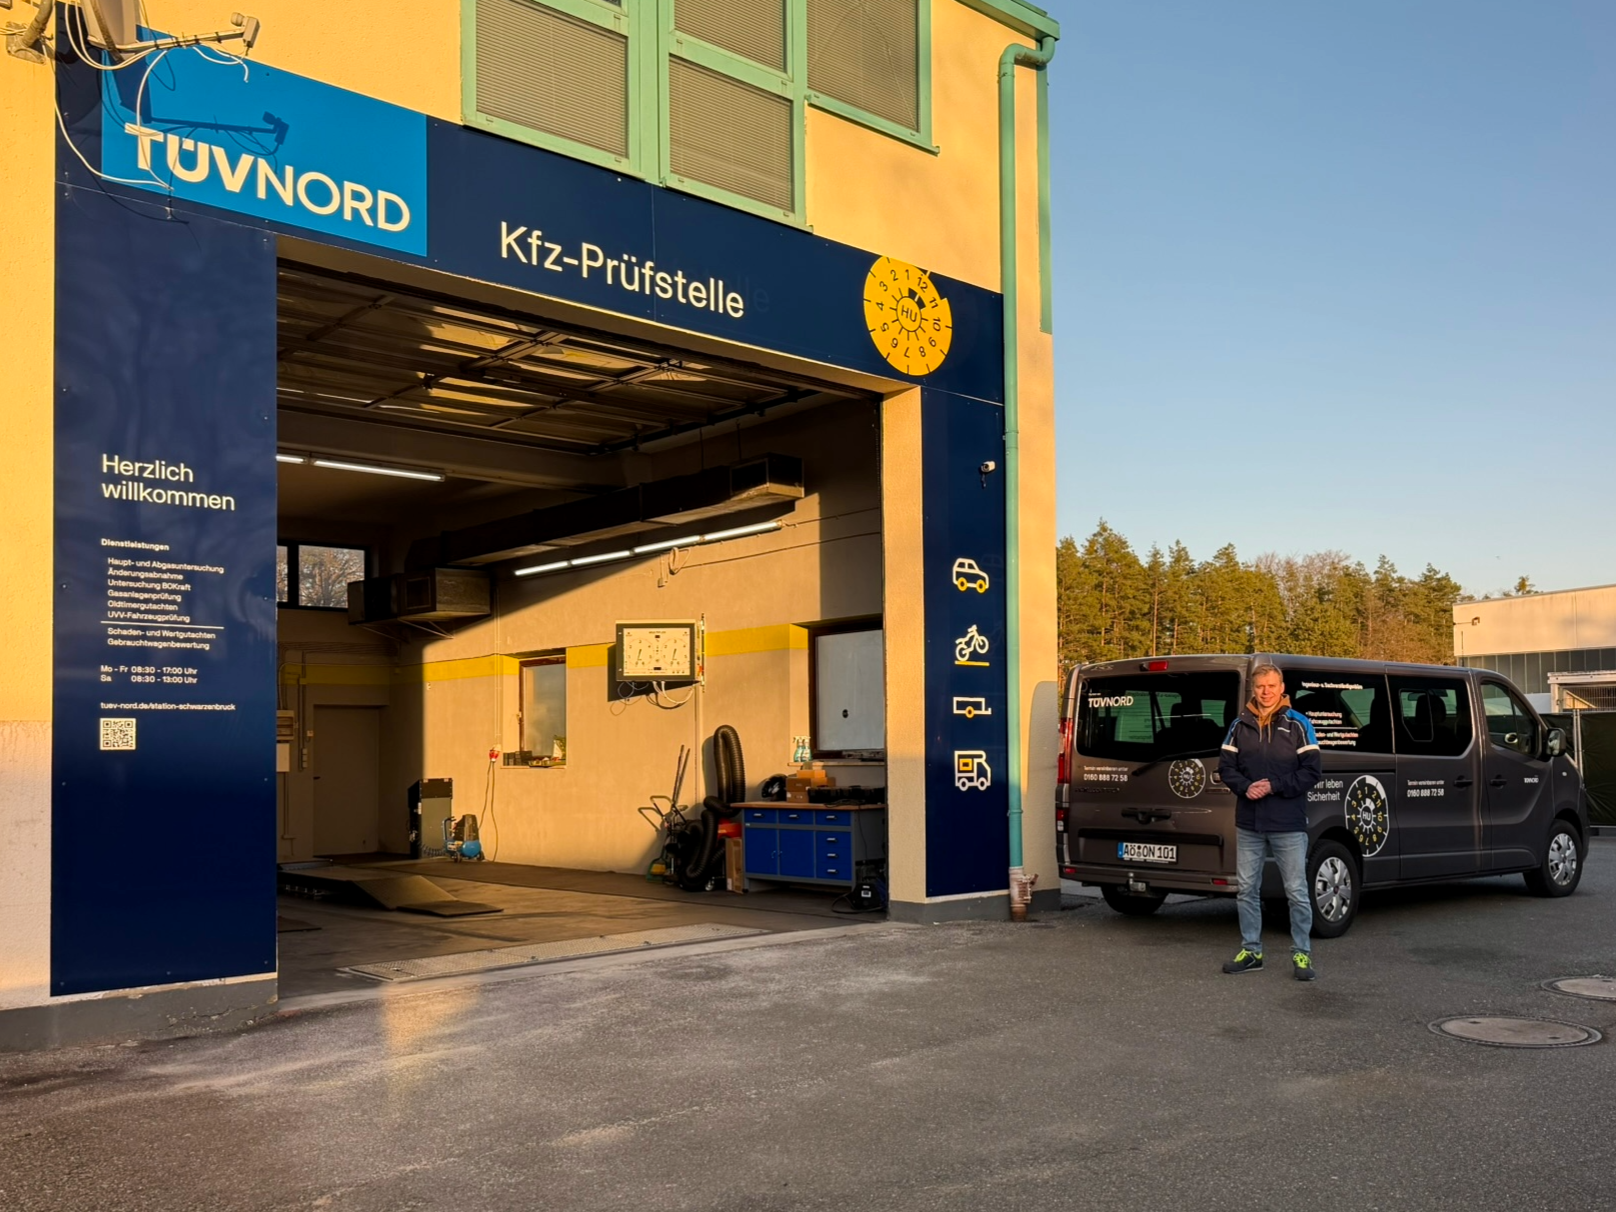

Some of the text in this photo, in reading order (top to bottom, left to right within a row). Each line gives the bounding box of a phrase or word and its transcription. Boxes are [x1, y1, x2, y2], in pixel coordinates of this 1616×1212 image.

[124, 122, 411, 232] TÜVNORD
[501, 221, 744, 318] Kfz-Prüfstelle
[890, 269, 898, 281] 2
[905, 269, 910, 281] 1
[879, 281, 888, 292] 3
[917, 276, 928, 293] 12
[876, 301, 884, 311] 4
[929, 297, 938, 309] 11
[901, 305, 918, 322] HU
[880, 322, 889, 332] 5
[932, 317, 941, 331] 10
[904, 347, 910, 358] 7
[919, 346, 926, 357] 8
[103, 454, 193, 482] Herzlich
[102, 481, 235, 511] willkommen
[101, 538, 169, 551] Dienstleistungen
[107, 557, 134, 567] Haupt-
[151, 561, 224, 574] Abgasuntersuchung
[107, 579, 191, 591] Untersuchung BOKraft
[107, 599, 178, 610] Oldtimergutachten
[107, 627, 216, 639] Schaden- und Wertgutachten
[184, 667, 198, 675] Uhr
[100, 674, 112, 682] Sa
[184, 676, 198, 684] Uhr
[1326, 779, 1344, 788] leben
[1307, 791, 1340, 802] Sicherheit
[1362, 811, 1371, 820] HU
[1377, 811, 1383, 822] 10
[1124, 844, 1175, 860] AÖ ON 101
